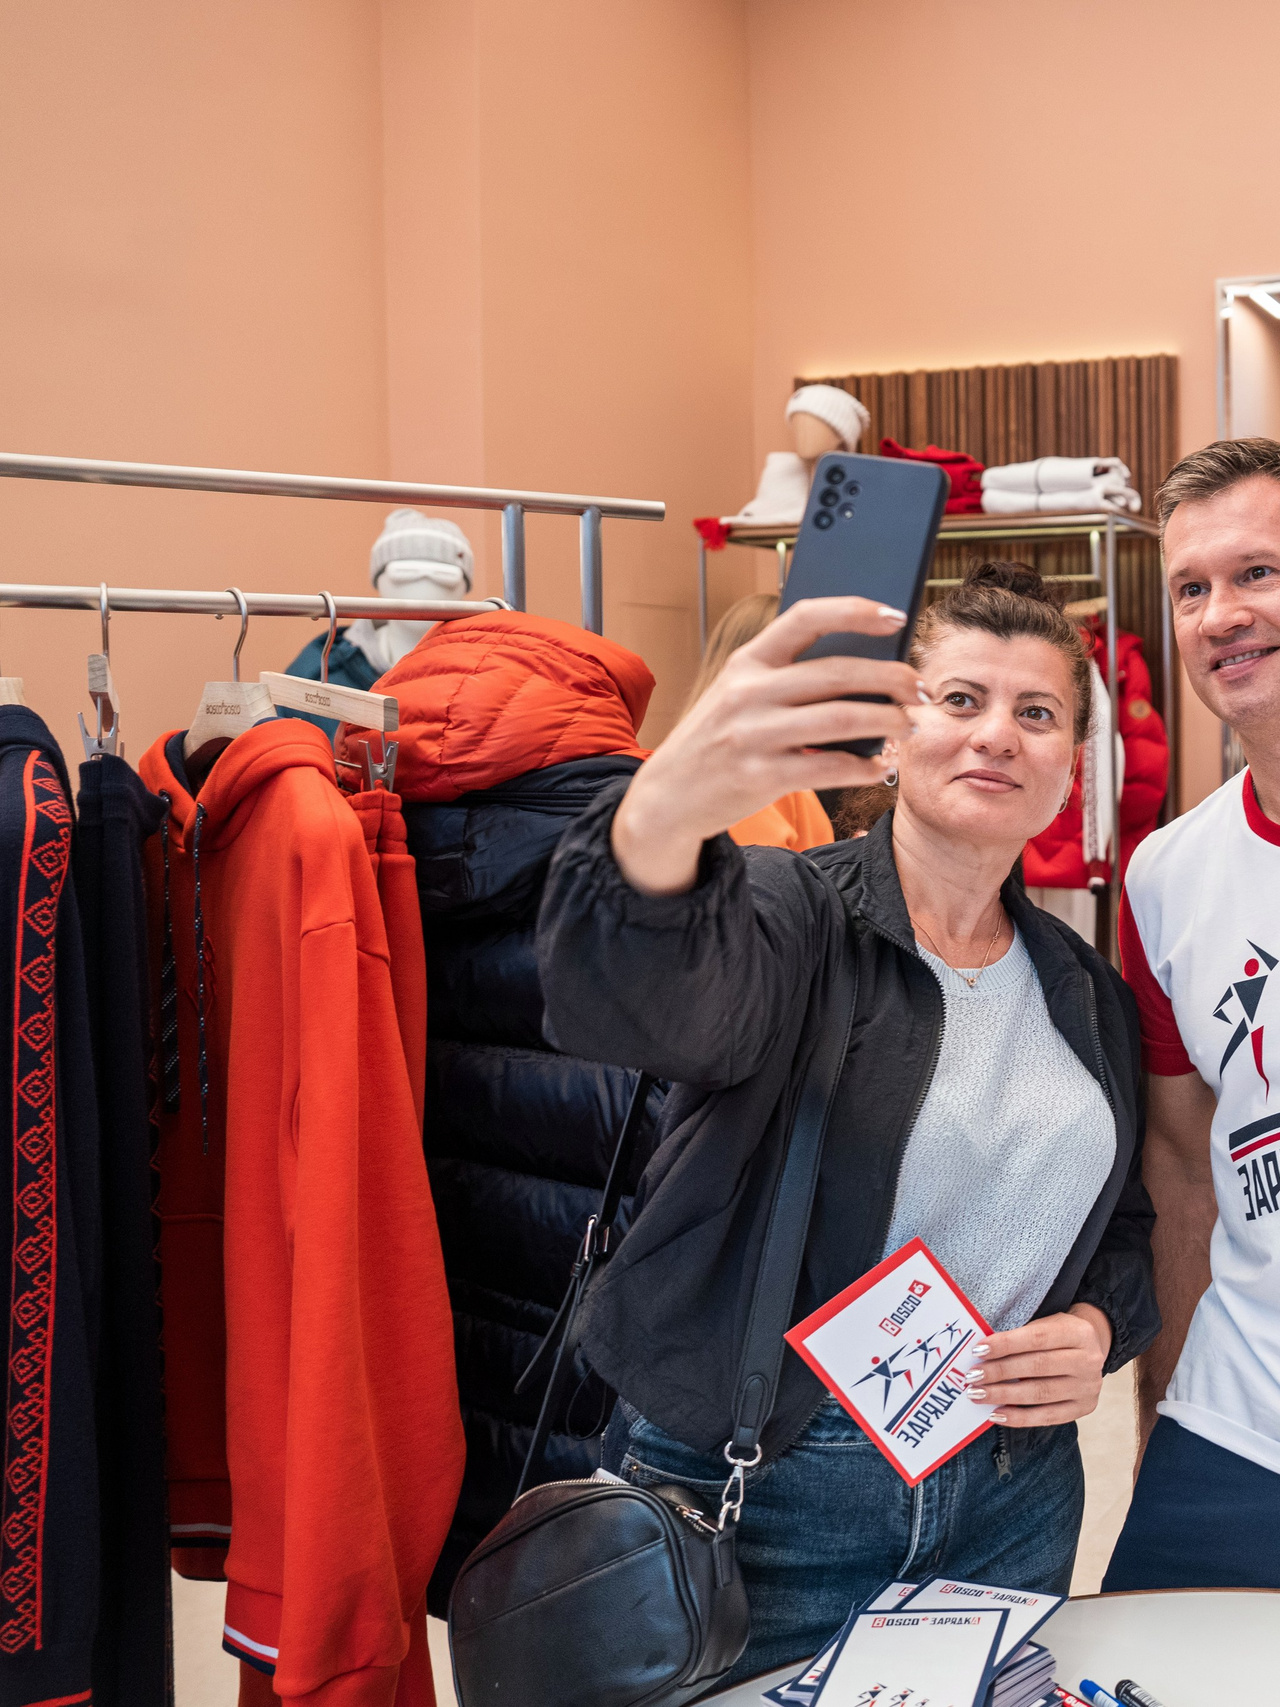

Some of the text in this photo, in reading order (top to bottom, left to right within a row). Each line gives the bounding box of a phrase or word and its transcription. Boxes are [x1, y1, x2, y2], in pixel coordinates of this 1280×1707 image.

[878, 1294, 922, 1337] BOSCO
[896, 1367, 970, 1449] ЗАРЯДКА
[939, 1583, 1039, 1607] BOSCO ЗАРЯДКА
[871, 1616, 982, 1629] BOSCO ЗАРЯДКА
